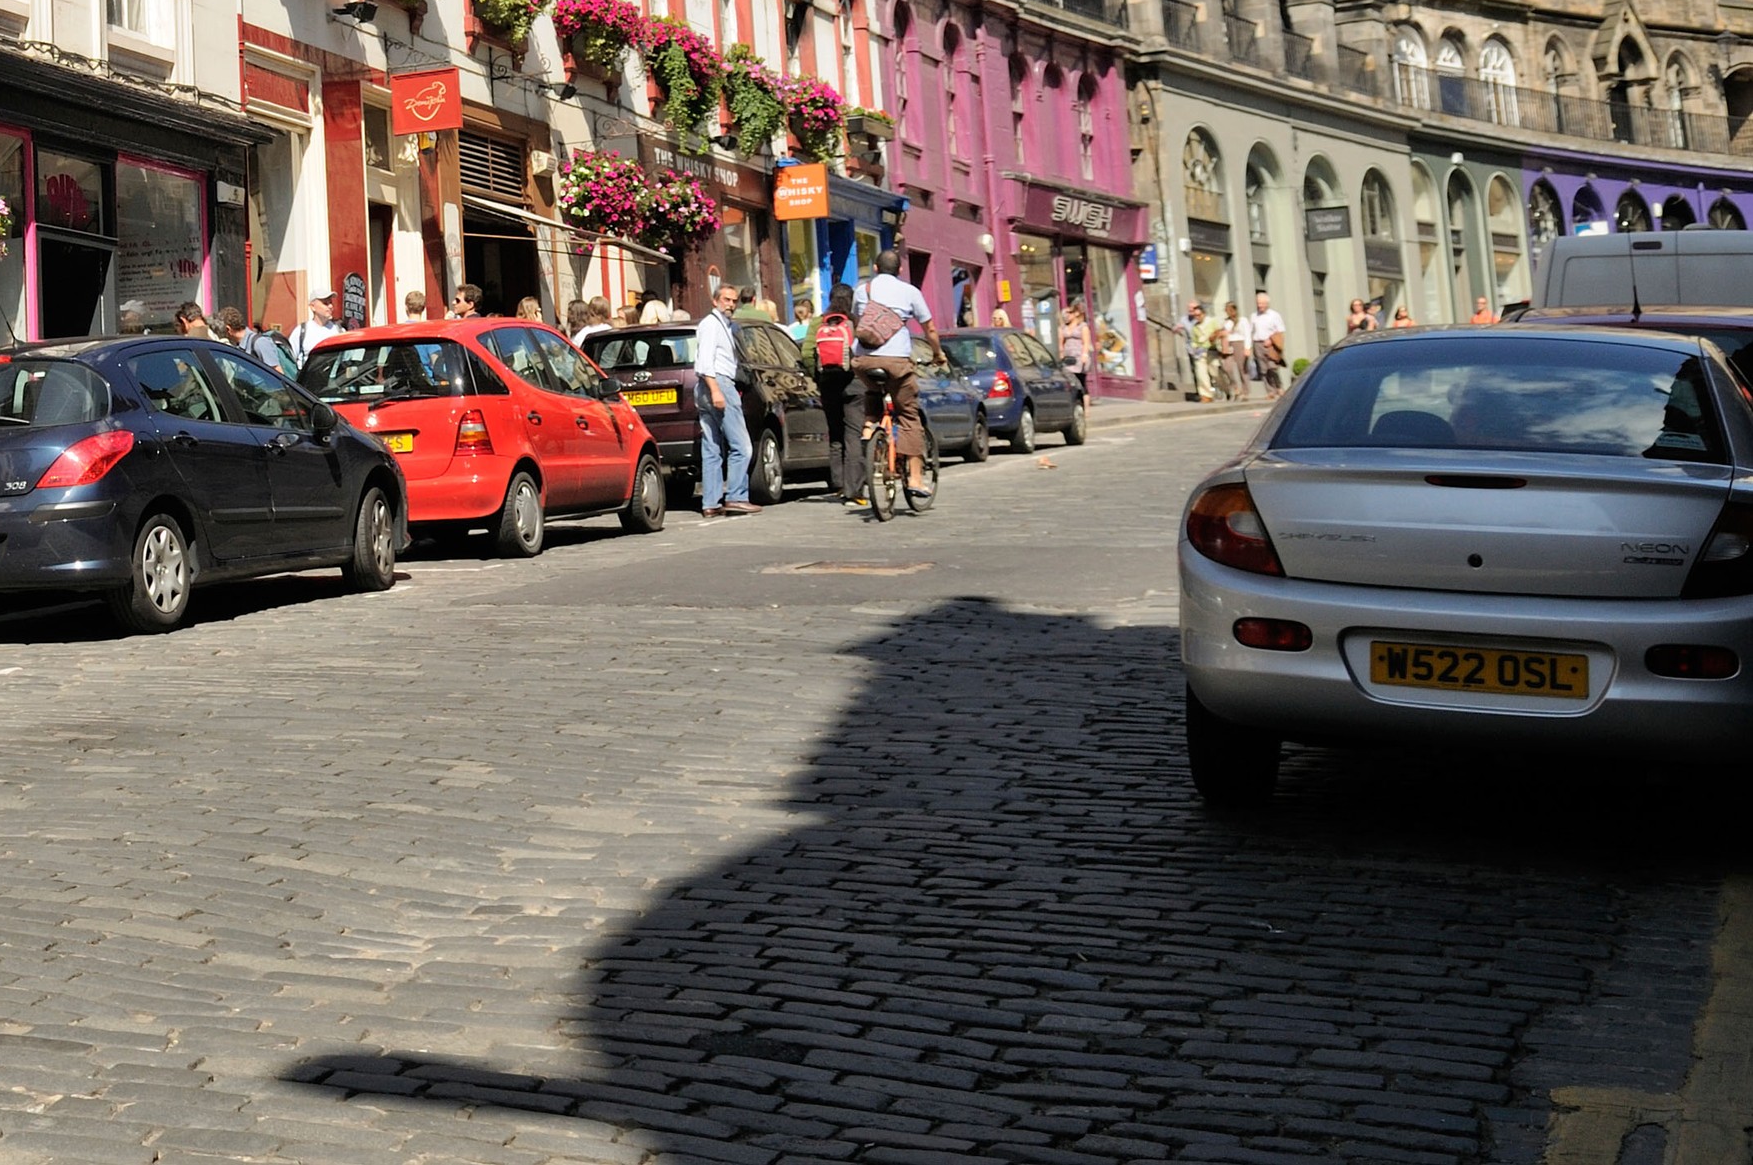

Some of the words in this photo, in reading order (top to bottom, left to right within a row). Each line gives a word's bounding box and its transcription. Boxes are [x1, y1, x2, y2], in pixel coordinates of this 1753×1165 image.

[654, 147, 674, 167] THE
[676, 154, 712, 179] WHISKY
[714, 166, 739, 188] SHOP
[777, 186, 824, 199] WHISKY
[789, 198, 813, 206] SHOP
[623, 391, 649, 404] M60
[4, 481, 27, 491] 308
[1621, 541, 1690, 555] NEON
[1386, 646, 1486, 685] W522
[1497, 654, 1573, 691] OSL
